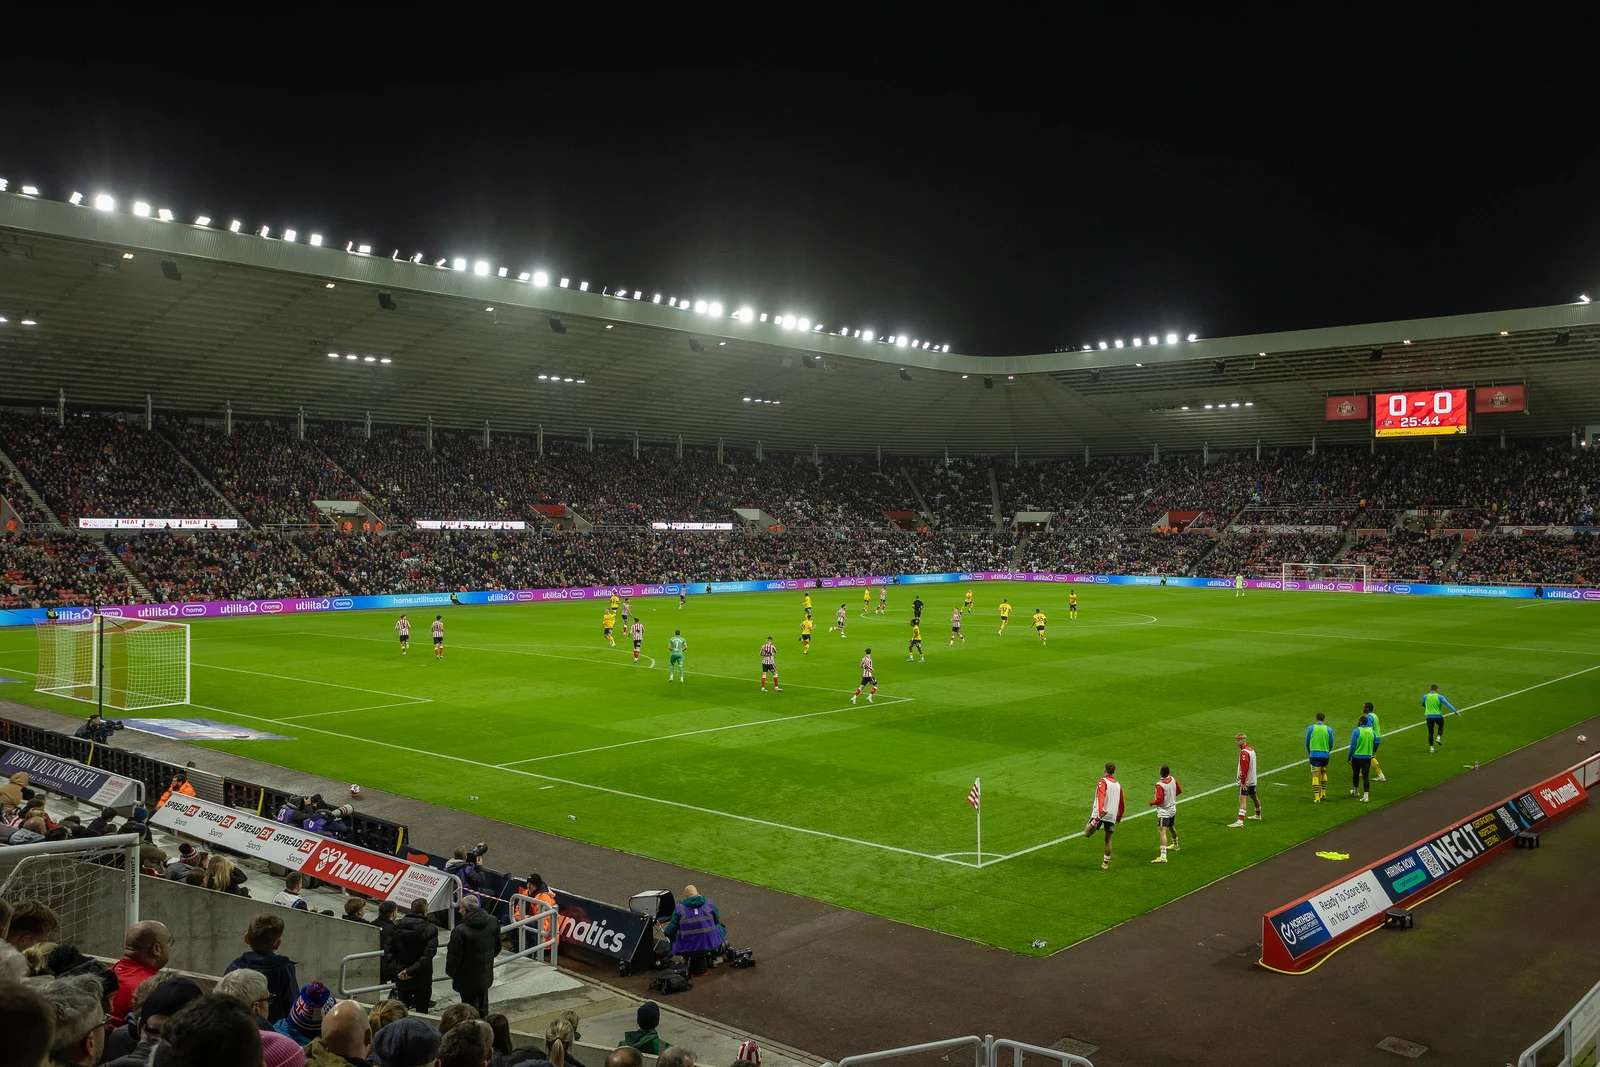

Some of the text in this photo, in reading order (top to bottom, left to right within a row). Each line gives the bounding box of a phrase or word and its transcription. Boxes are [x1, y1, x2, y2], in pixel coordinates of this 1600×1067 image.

[1389, 394, 1407, 416] 0
[1434, 392, 1452, 414] 0
[1400, 416, 1440, 428] 25:44
[594, 589, 612, 597] utilita
[220, 603, 248, 614] utilita
[296, 600, 321, 610] utilita
[58, 611, 81, 620] ilita
[138, 607, 168, 617] utilita
[5, 750, 100, 788] JOHN DUCKWORTH
[174, 817, 187, 827] Sports
[208, 828, 223, 839] Sports
[246, 840, 262, 851] Sports
[286, 853, 305, 865] Sports
[329, 853, 404, 893] hummel
[1384, 856, 1416, 878] HIRING NOW
[408, 870, 440, 886] WARNING
[1319, 881, 1371, 911] Ready To Score Big
[1328, 898, 1370, 926] in Your Career?
[1289, 911, 1316, 929] NORTHERN
[561, 916, 626, 953] natics
